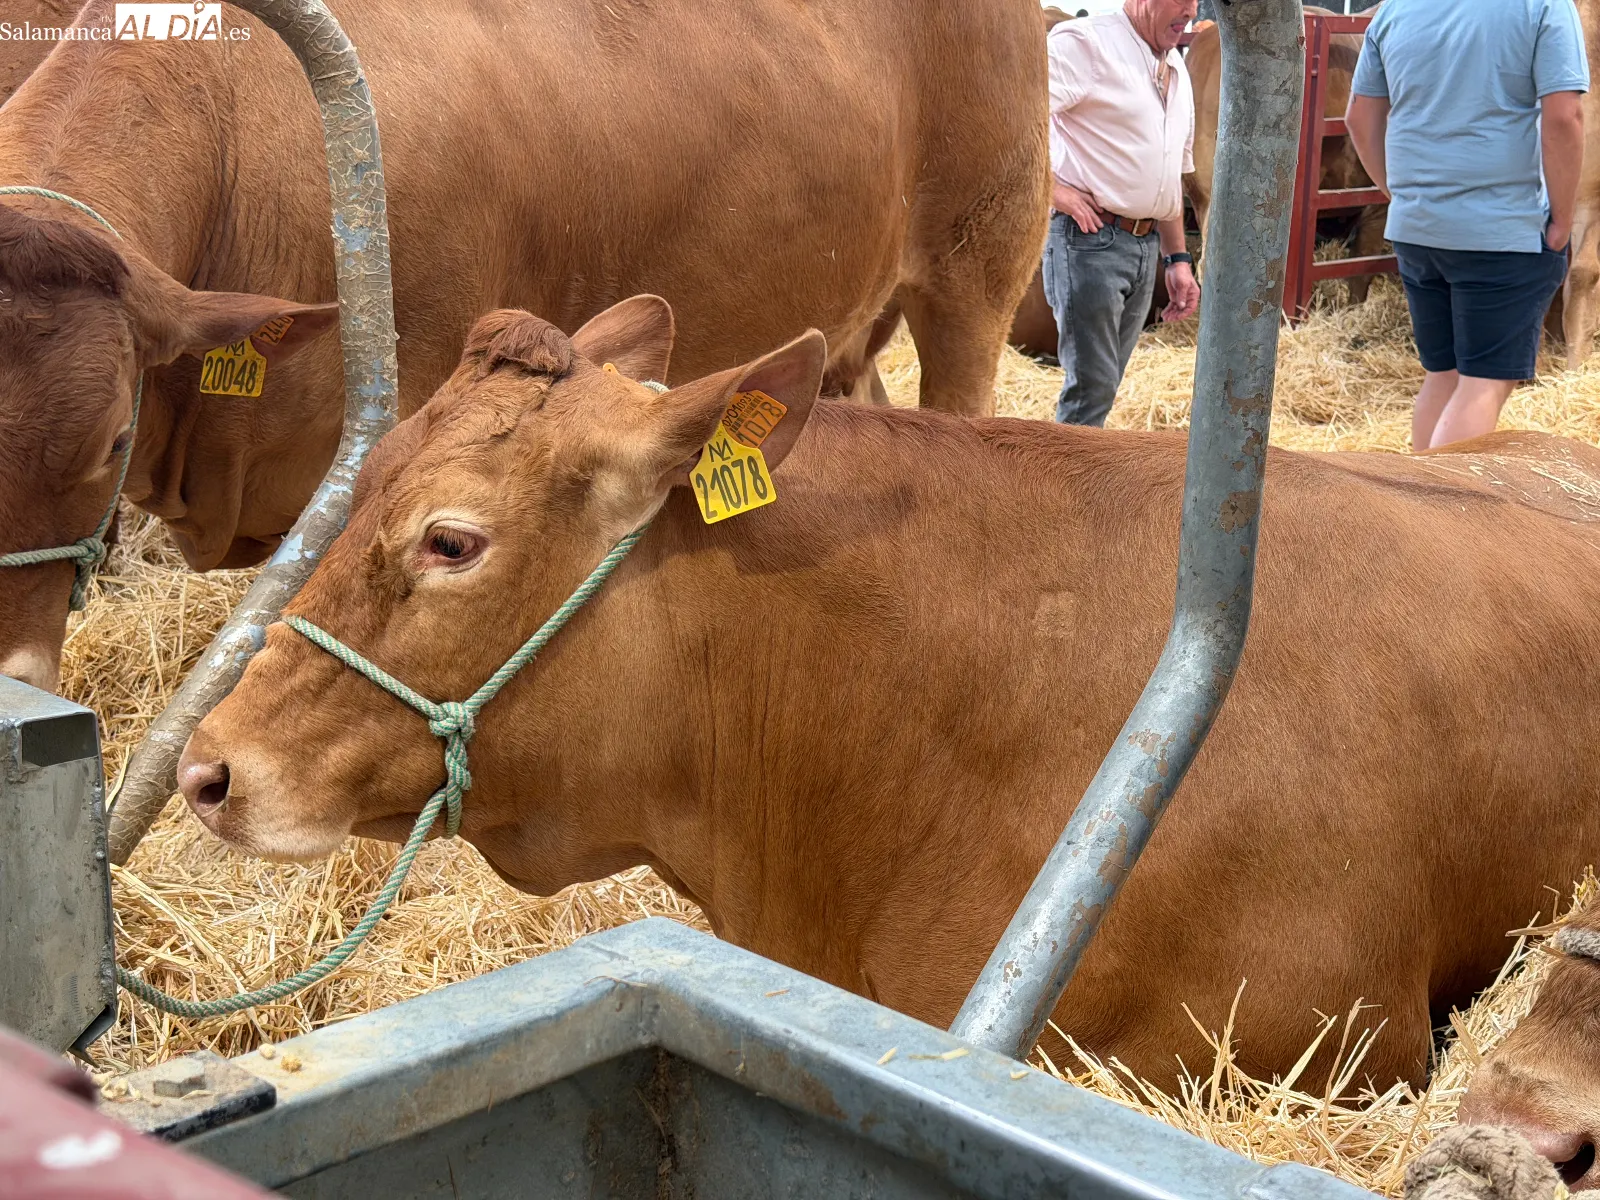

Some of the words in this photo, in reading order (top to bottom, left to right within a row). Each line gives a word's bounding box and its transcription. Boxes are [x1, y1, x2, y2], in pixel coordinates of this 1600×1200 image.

[200, 355, 258, 394] 20048
[735, 401, 784, 448] 1078
[695, 455, 768, 519] 21078
